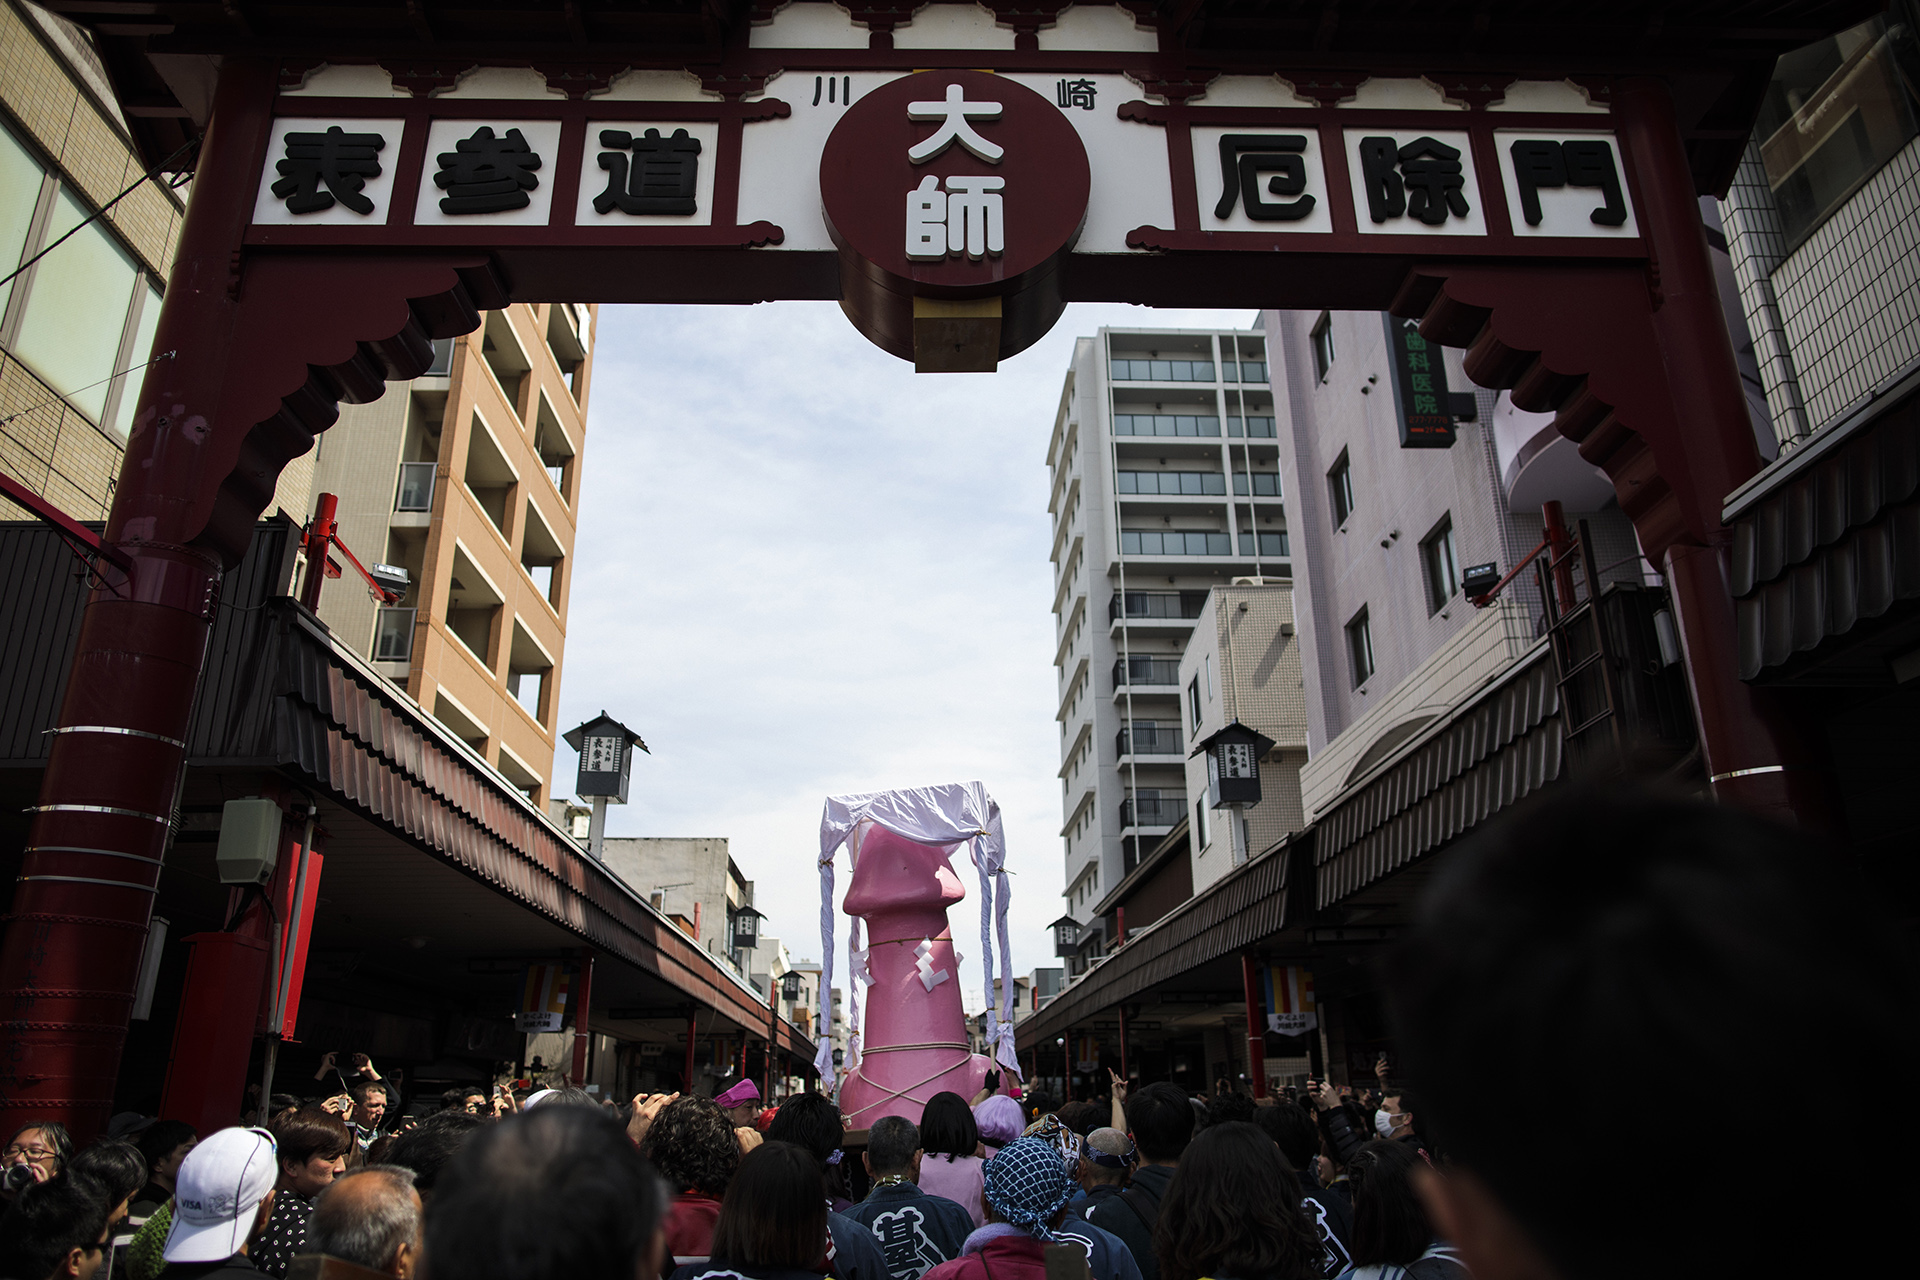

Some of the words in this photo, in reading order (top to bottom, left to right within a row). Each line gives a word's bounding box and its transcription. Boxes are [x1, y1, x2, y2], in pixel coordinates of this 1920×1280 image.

[812, 76, 851, 107] 川
[1056, 78, 1098, 110] 崎
[270, 126, 702, 215] 表参道
[905, 83, 1006, 261] 大師
[1214, 134, 1627, 226] 厄除門
[1424, 425, 1435, 434] 2F
[181, 1198, 202, 1211] VISA
